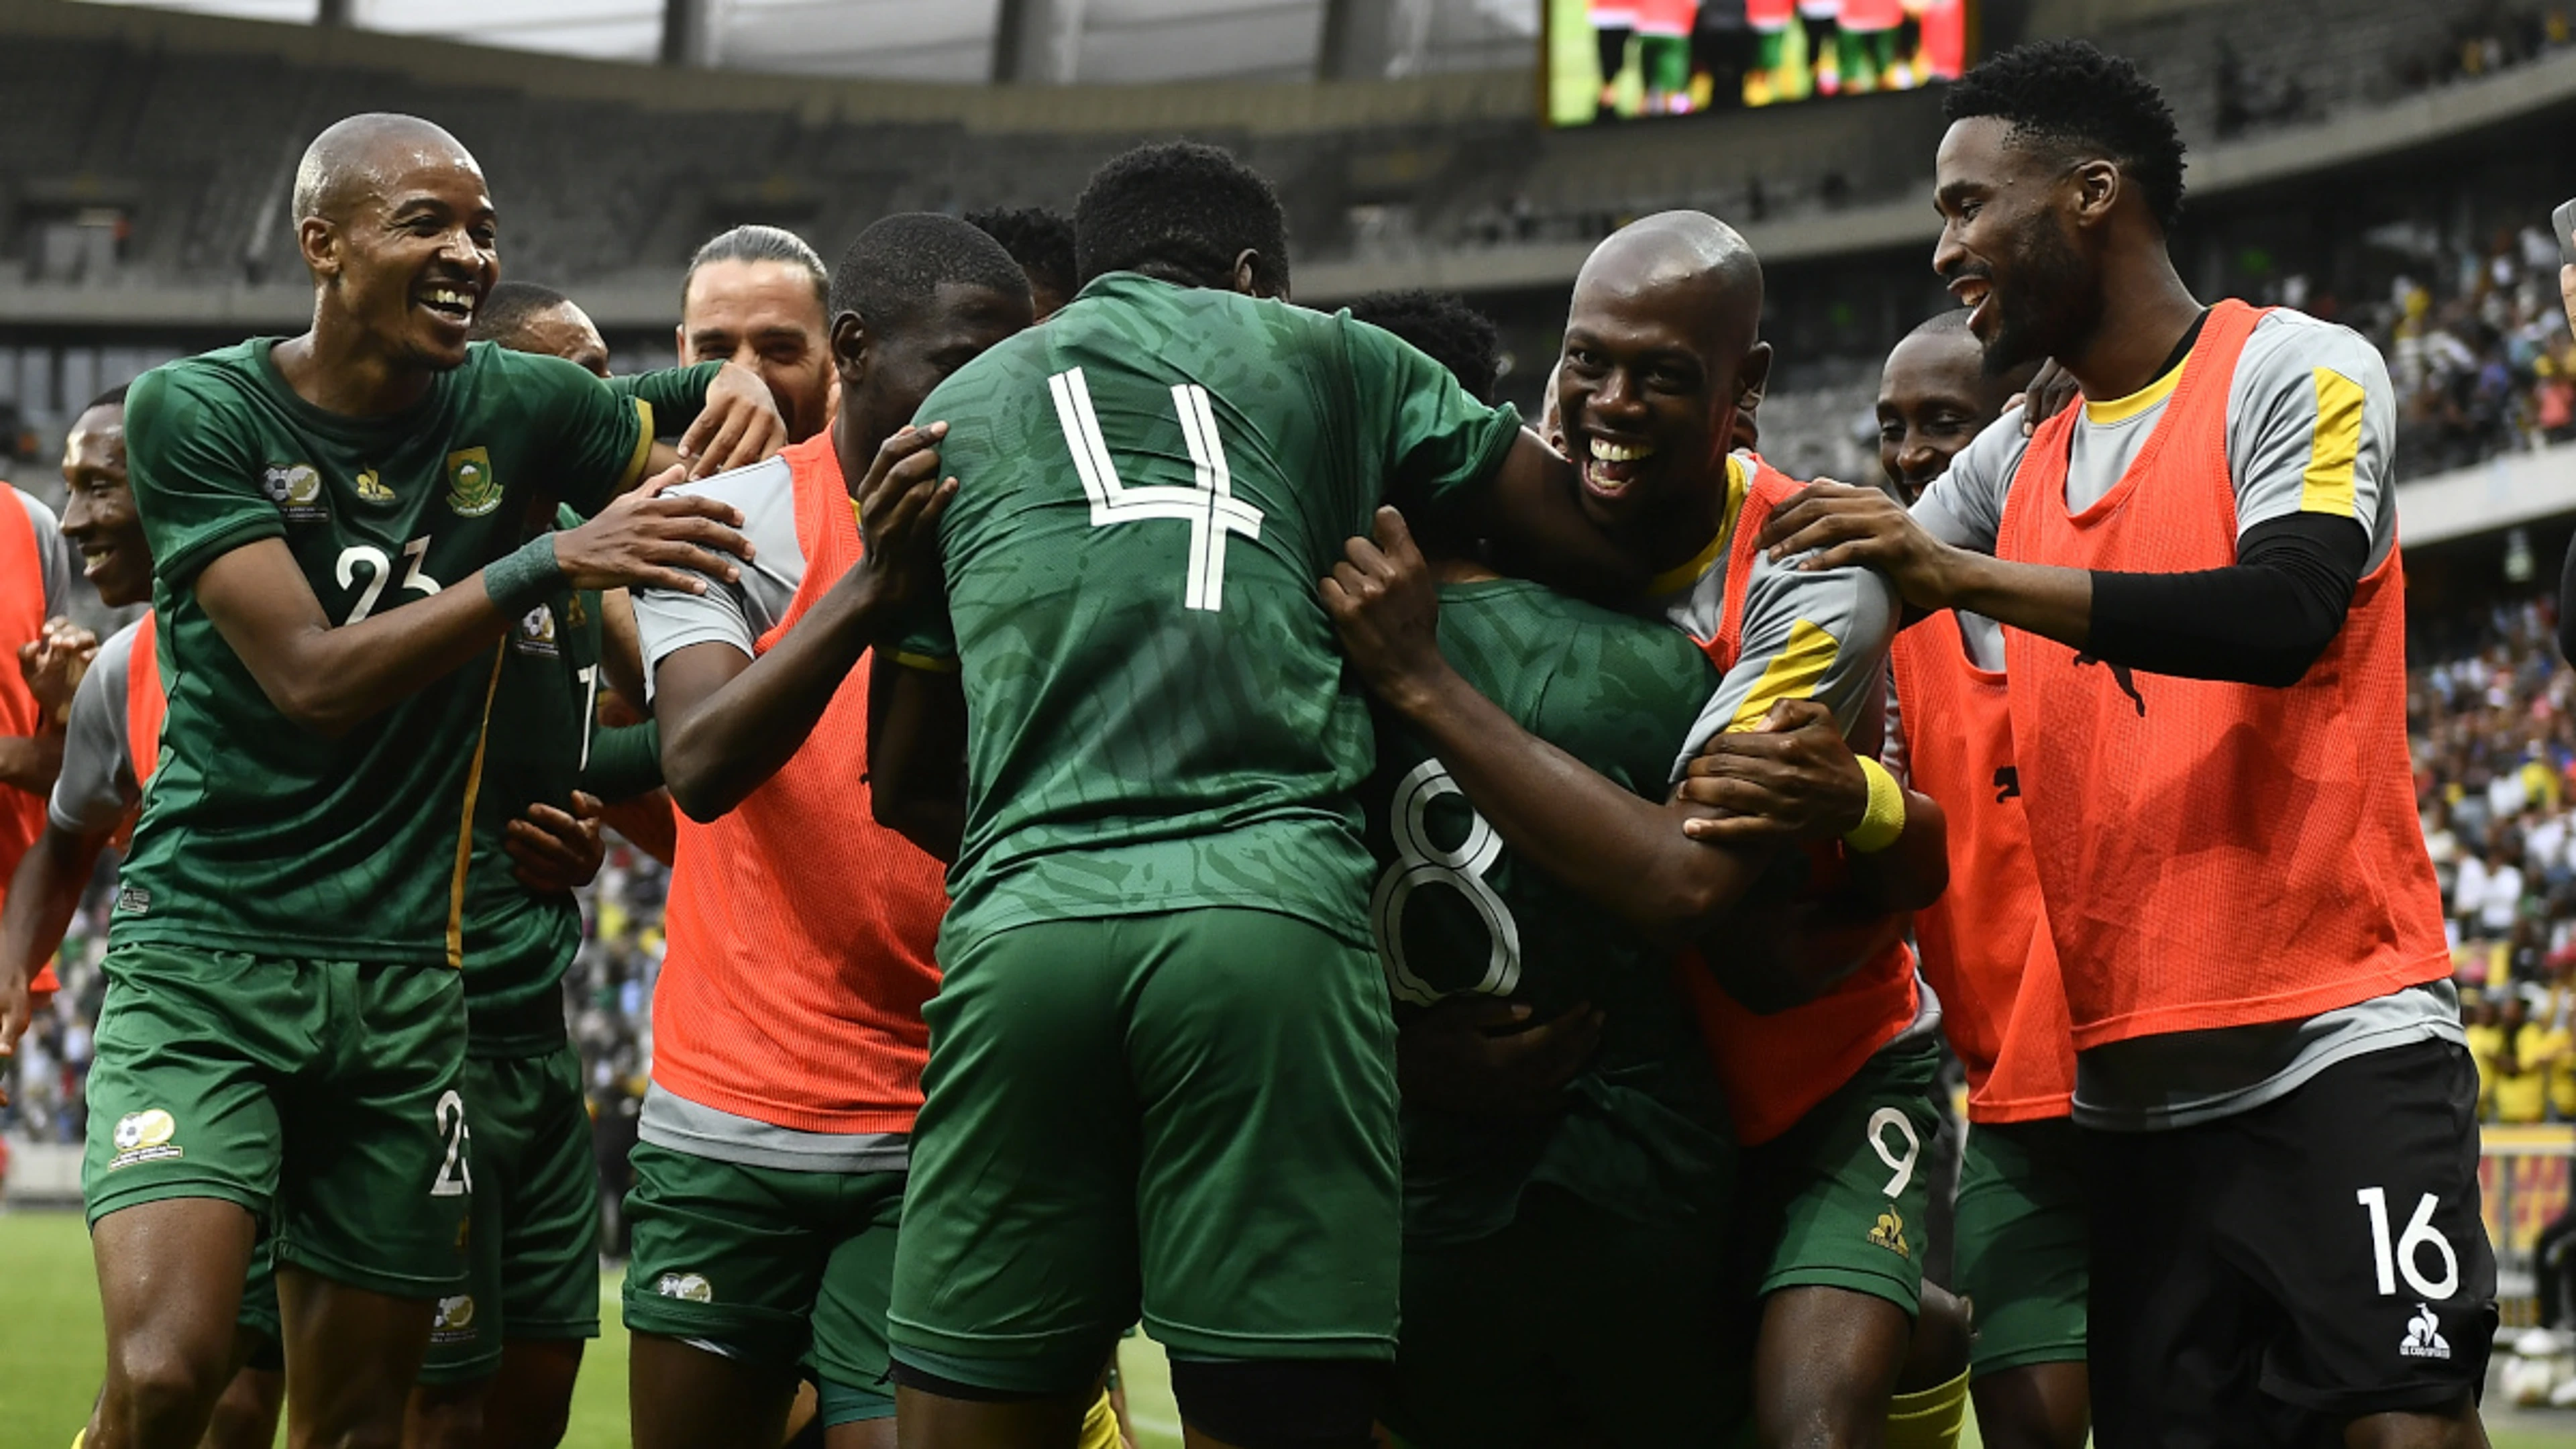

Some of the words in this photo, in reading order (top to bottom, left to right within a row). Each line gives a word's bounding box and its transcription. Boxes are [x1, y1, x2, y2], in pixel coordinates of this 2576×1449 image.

[1048, 366, 1265, 612] 4
[1370, 757, 1521, 1007] 8
[430, 1089, 472, 1196] 2
[1867, 1107, 1920, 1199] 9
[2357, 1187, 2459, 1299] 16
